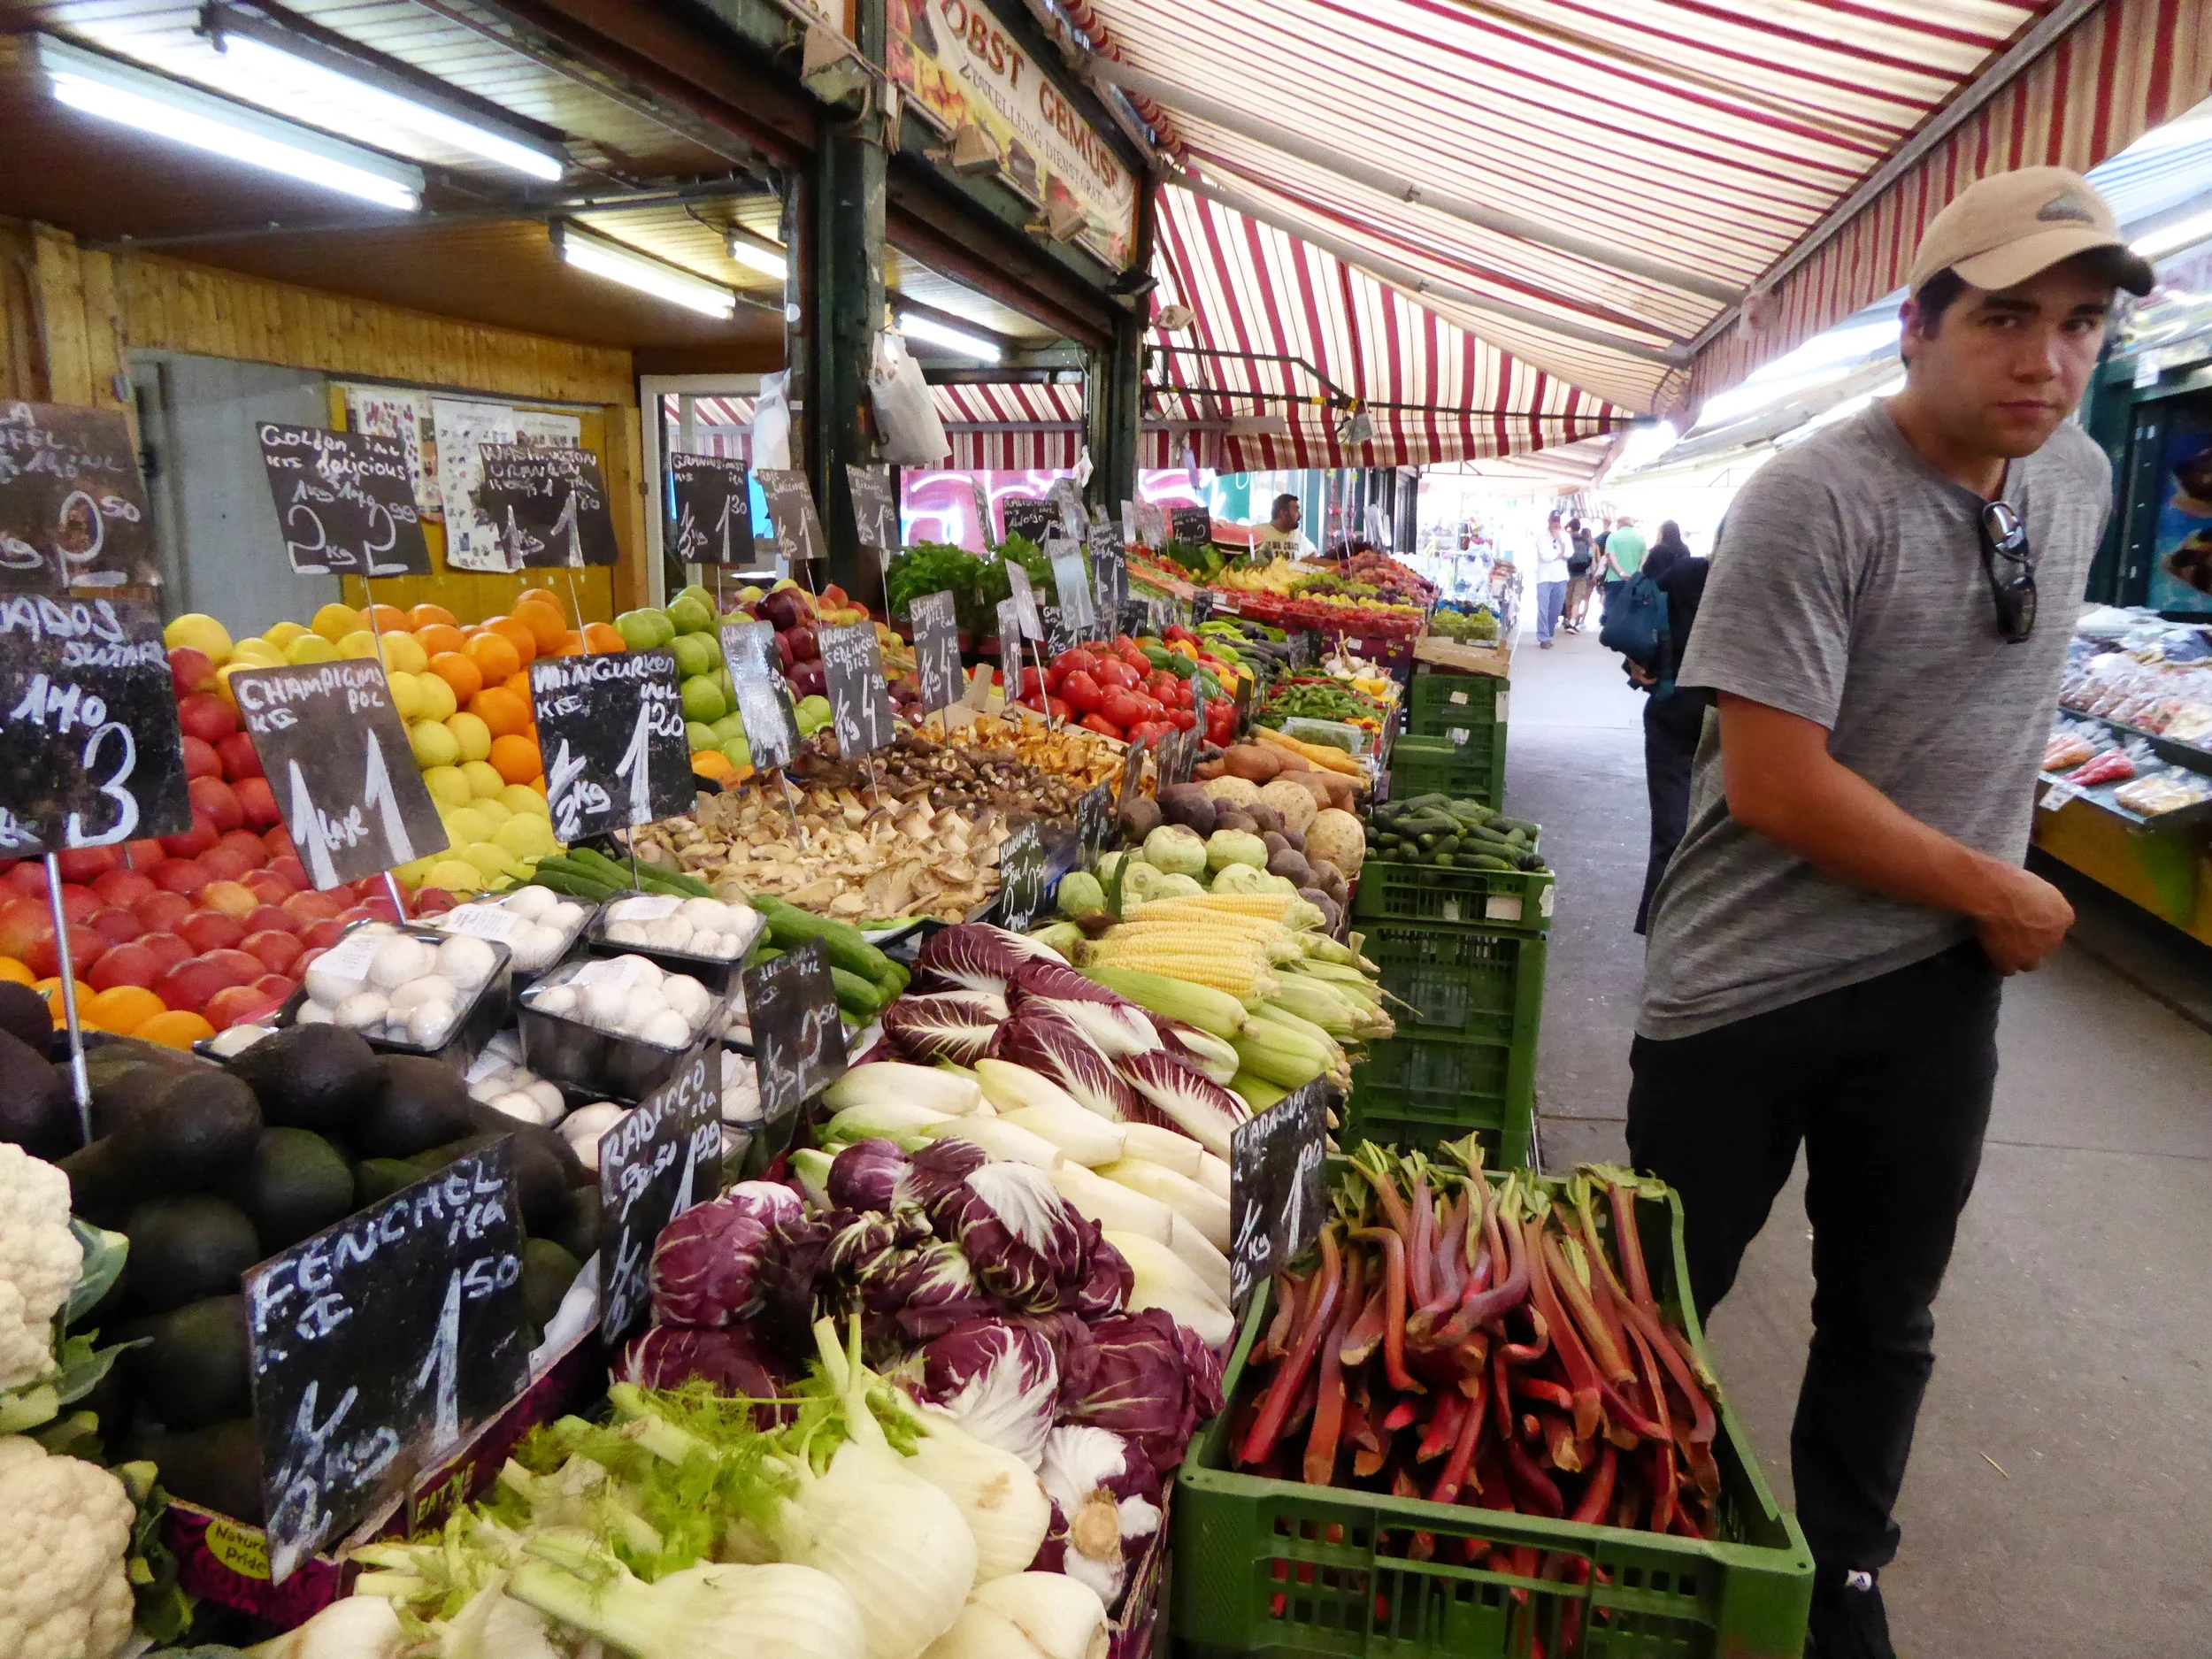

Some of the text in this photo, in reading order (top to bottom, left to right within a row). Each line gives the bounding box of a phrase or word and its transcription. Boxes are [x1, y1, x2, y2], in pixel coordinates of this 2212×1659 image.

[940, 0, 1025, 89] OBST
[66, 722, 140, 849] 3
[225, 1545, 267, 1574] Pride
